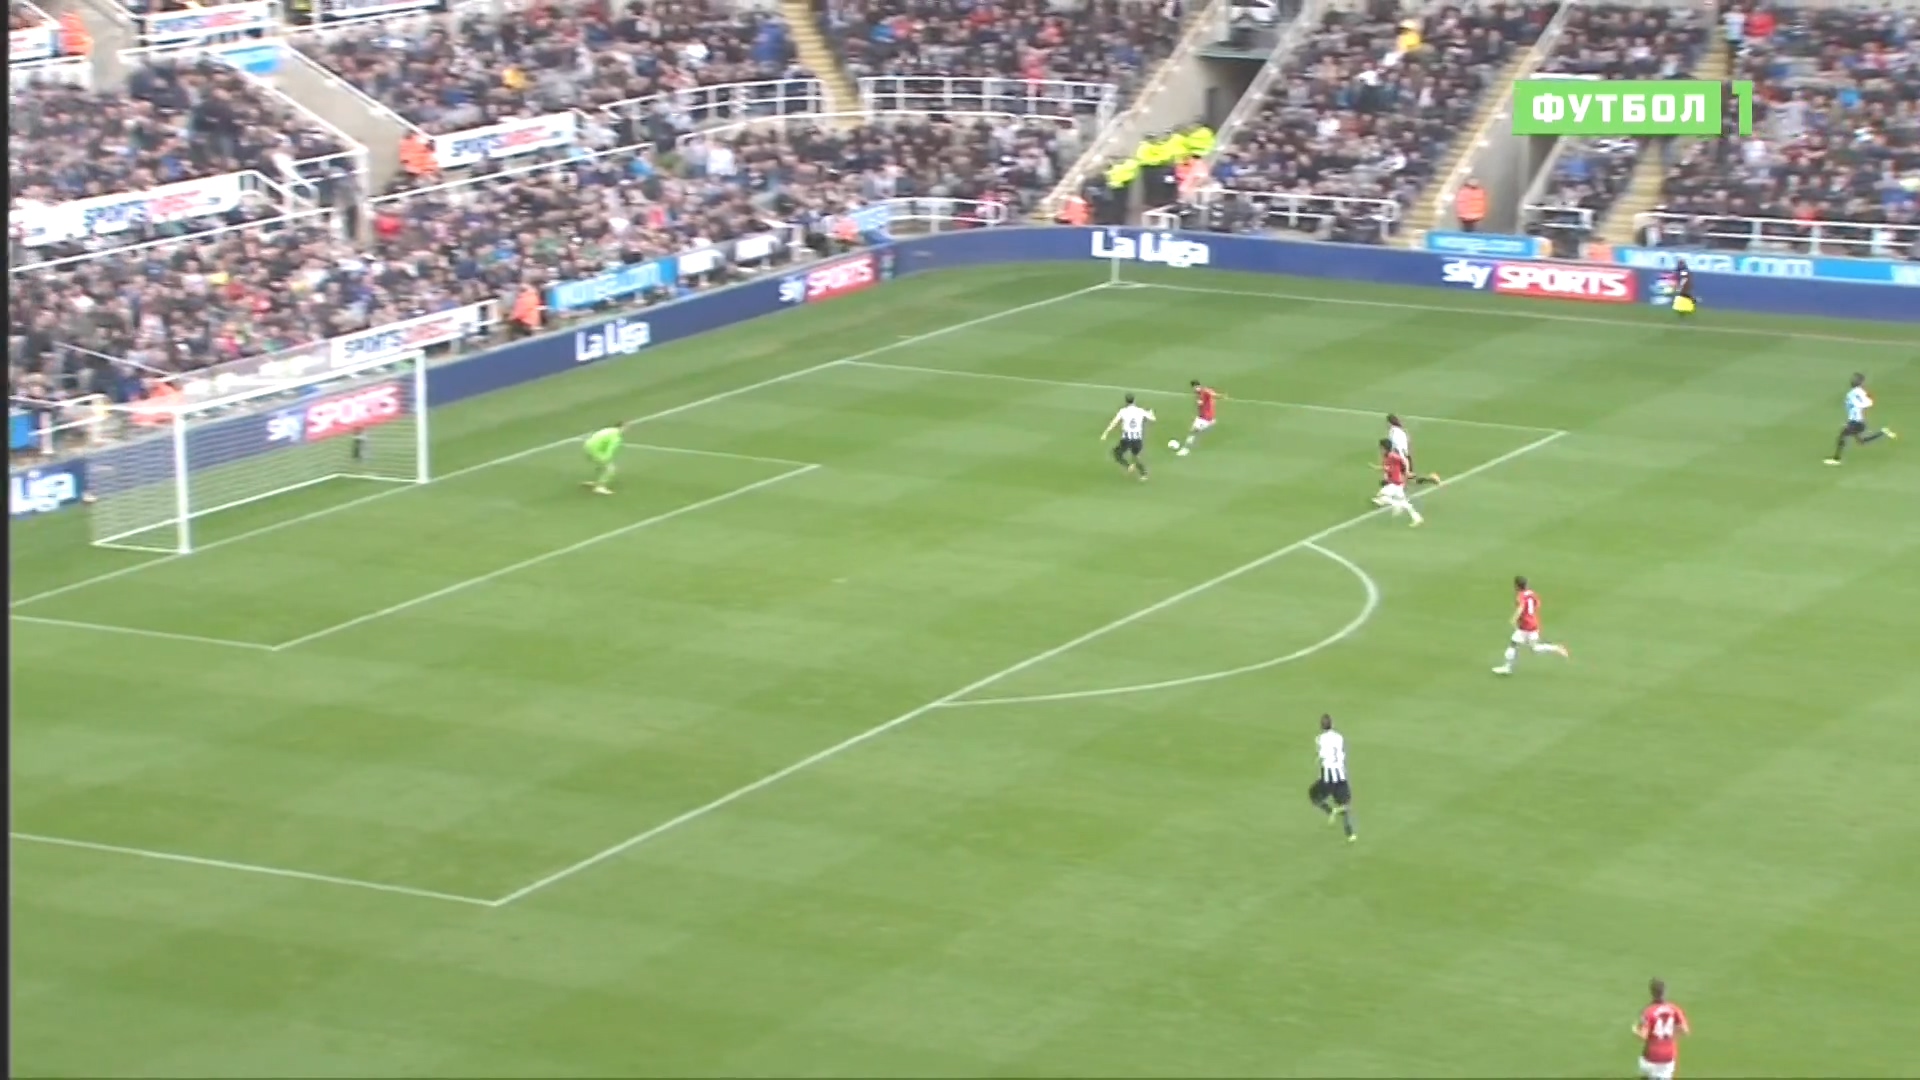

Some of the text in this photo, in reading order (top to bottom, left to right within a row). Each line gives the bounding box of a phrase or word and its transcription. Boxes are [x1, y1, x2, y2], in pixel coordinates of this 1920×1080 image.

[1091, 230, 1210, 268] La Liga
[1622, 249, 1815, 279] wonga.com
[779, 257, 874, 303] sky SPORTS
[1442, 258, 1628, 298] sky SPORTS
[575, 317, 650, 362] La Liga
[305, 385, 400, 433] SPORTS
[1653, 1016, 1675, 1040] 44
